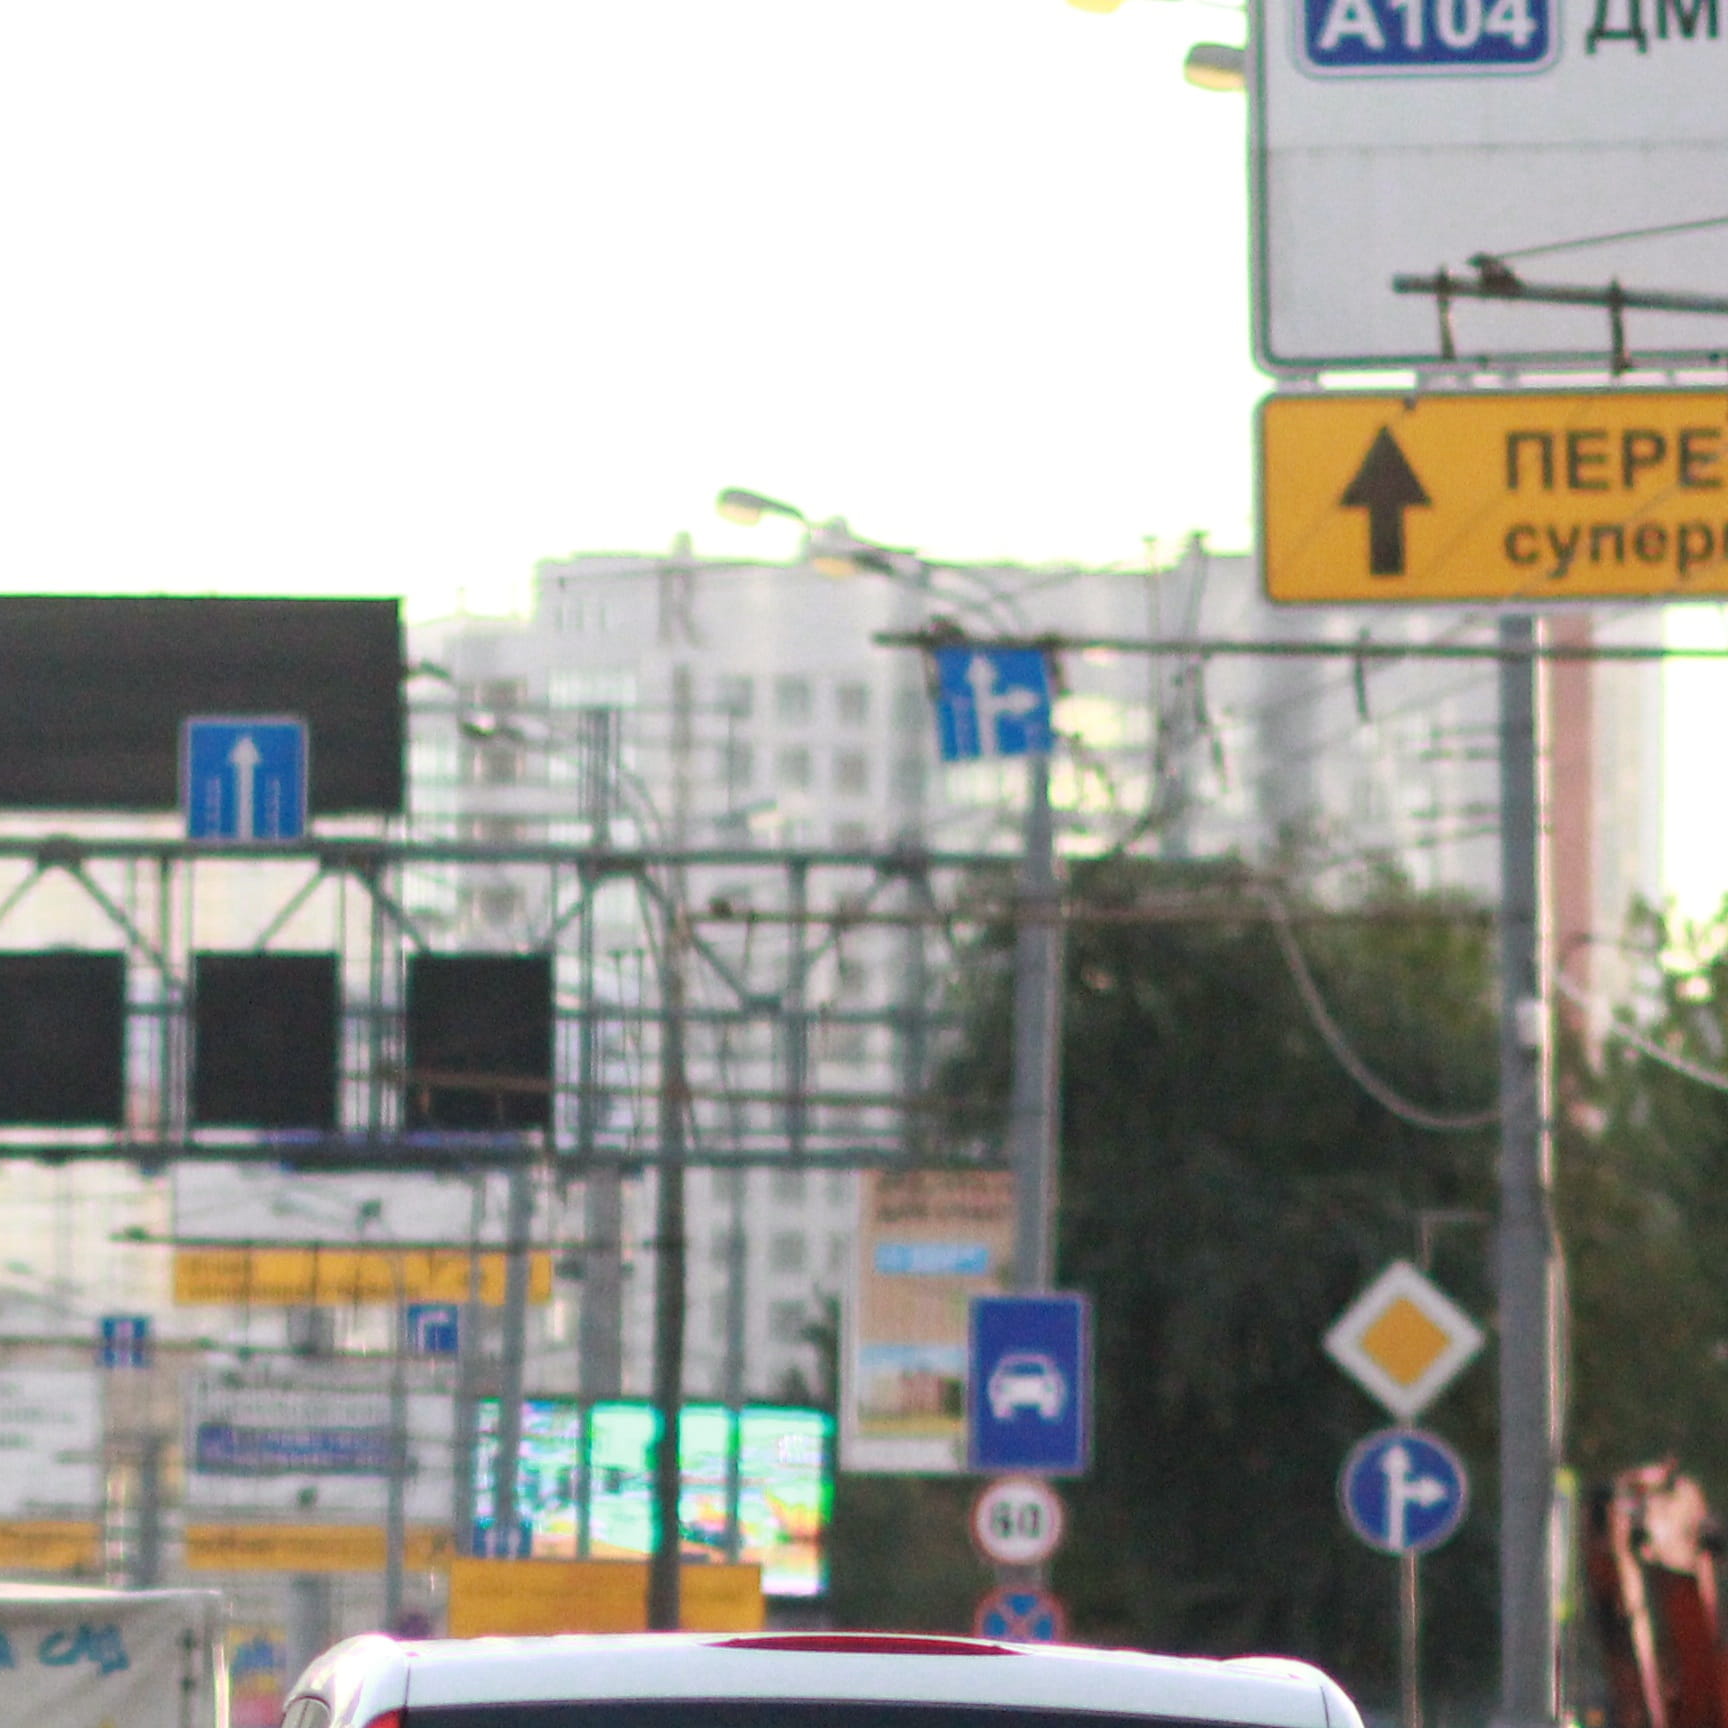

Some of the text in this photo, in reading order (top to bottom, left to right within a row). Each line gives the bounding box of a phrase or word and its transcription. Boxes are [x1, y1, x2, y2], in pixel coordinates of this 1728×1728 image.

[1504, 427, 1723, 492] ПЕРЕ
[1502, 522, 1728, 578] супер
[988, 1501, 1045, 1540] 60
